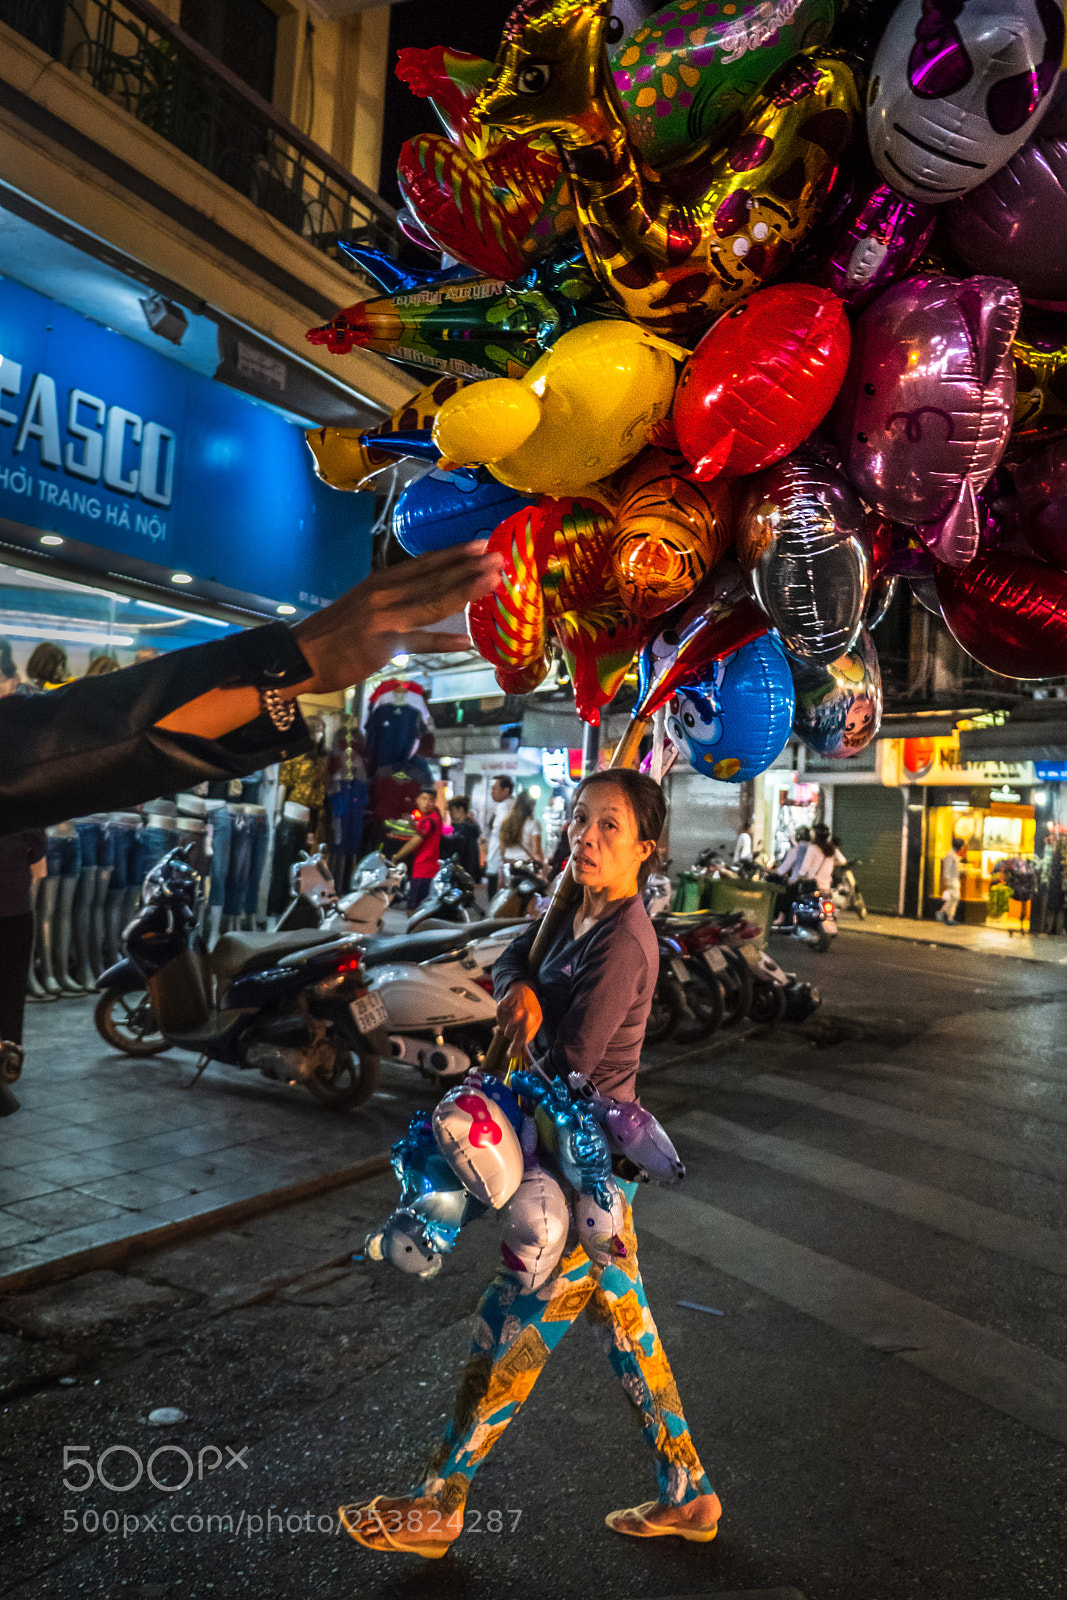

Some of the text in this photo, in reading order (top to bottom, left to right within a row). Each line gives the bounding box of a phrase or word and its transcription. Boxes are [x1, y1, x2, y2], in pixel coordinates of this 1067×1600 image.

[38, 479, 102, 519] TRANG
[105, 503, 131, 529] HÀ
[135, 513, 167, 543] NỘI
